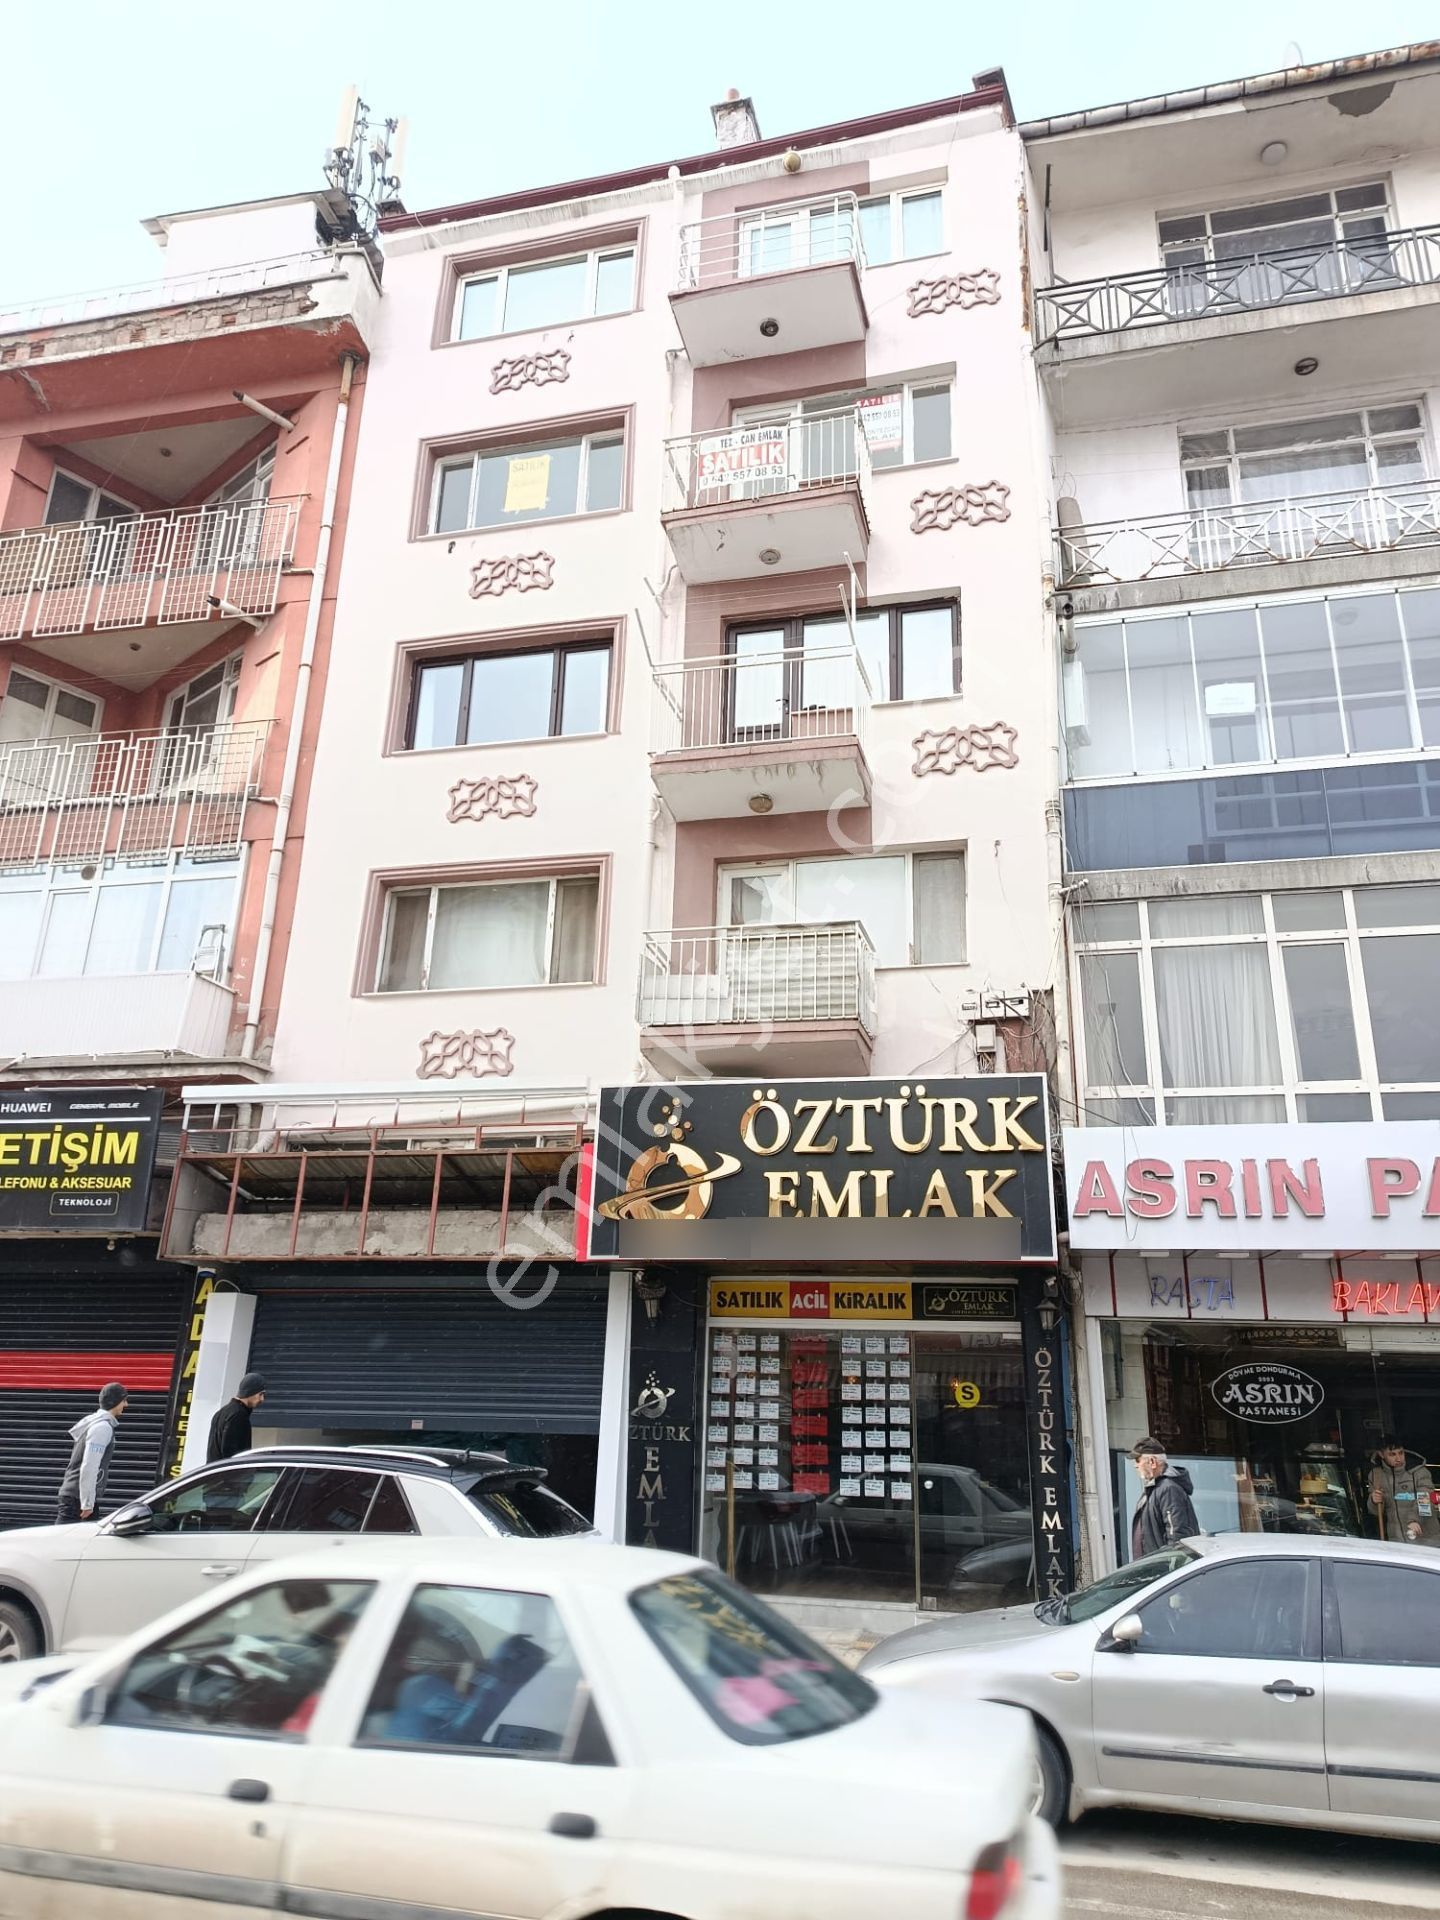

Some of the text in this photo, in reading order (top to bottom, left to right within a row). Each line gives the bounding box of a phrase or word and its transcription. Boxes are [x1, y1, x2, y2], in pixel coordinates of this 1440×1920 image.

[741, 433, 756, 445] CAN
[758, 429, 783, 442] EMLAK
[702, 443, 784, 474] SATILIK
[733, 468, 752, 481] 557
[755, 466, 768, 477] 08
[771, 465, 784, 476] 53
[0, 1102, 52, 1113] HUAWEI
[740, 1084, 1045, 1156] ÖZTÜRK
[0, 1123, 139, 1173] ETİŞİM
[49, 1177, 59, 1189] &
[60, 1177, 132, 1189] AKSESUAR
[763, 1168, 1019, 1218] EMLAK
[1072, 1158, 1326, 1218] ASRIN
[716, 1290, 783, 1309] SATILIK
[791, 1288, 829, 1310] ACİL
[964, 1302, 994, 1311] EMLAK
[961, 1385, 975, 1401] S
[1222, 1382, 1315, 1405] ASRIN
[1034, 1347, 1065, 1599] ÖZTÜRK EMLAK
